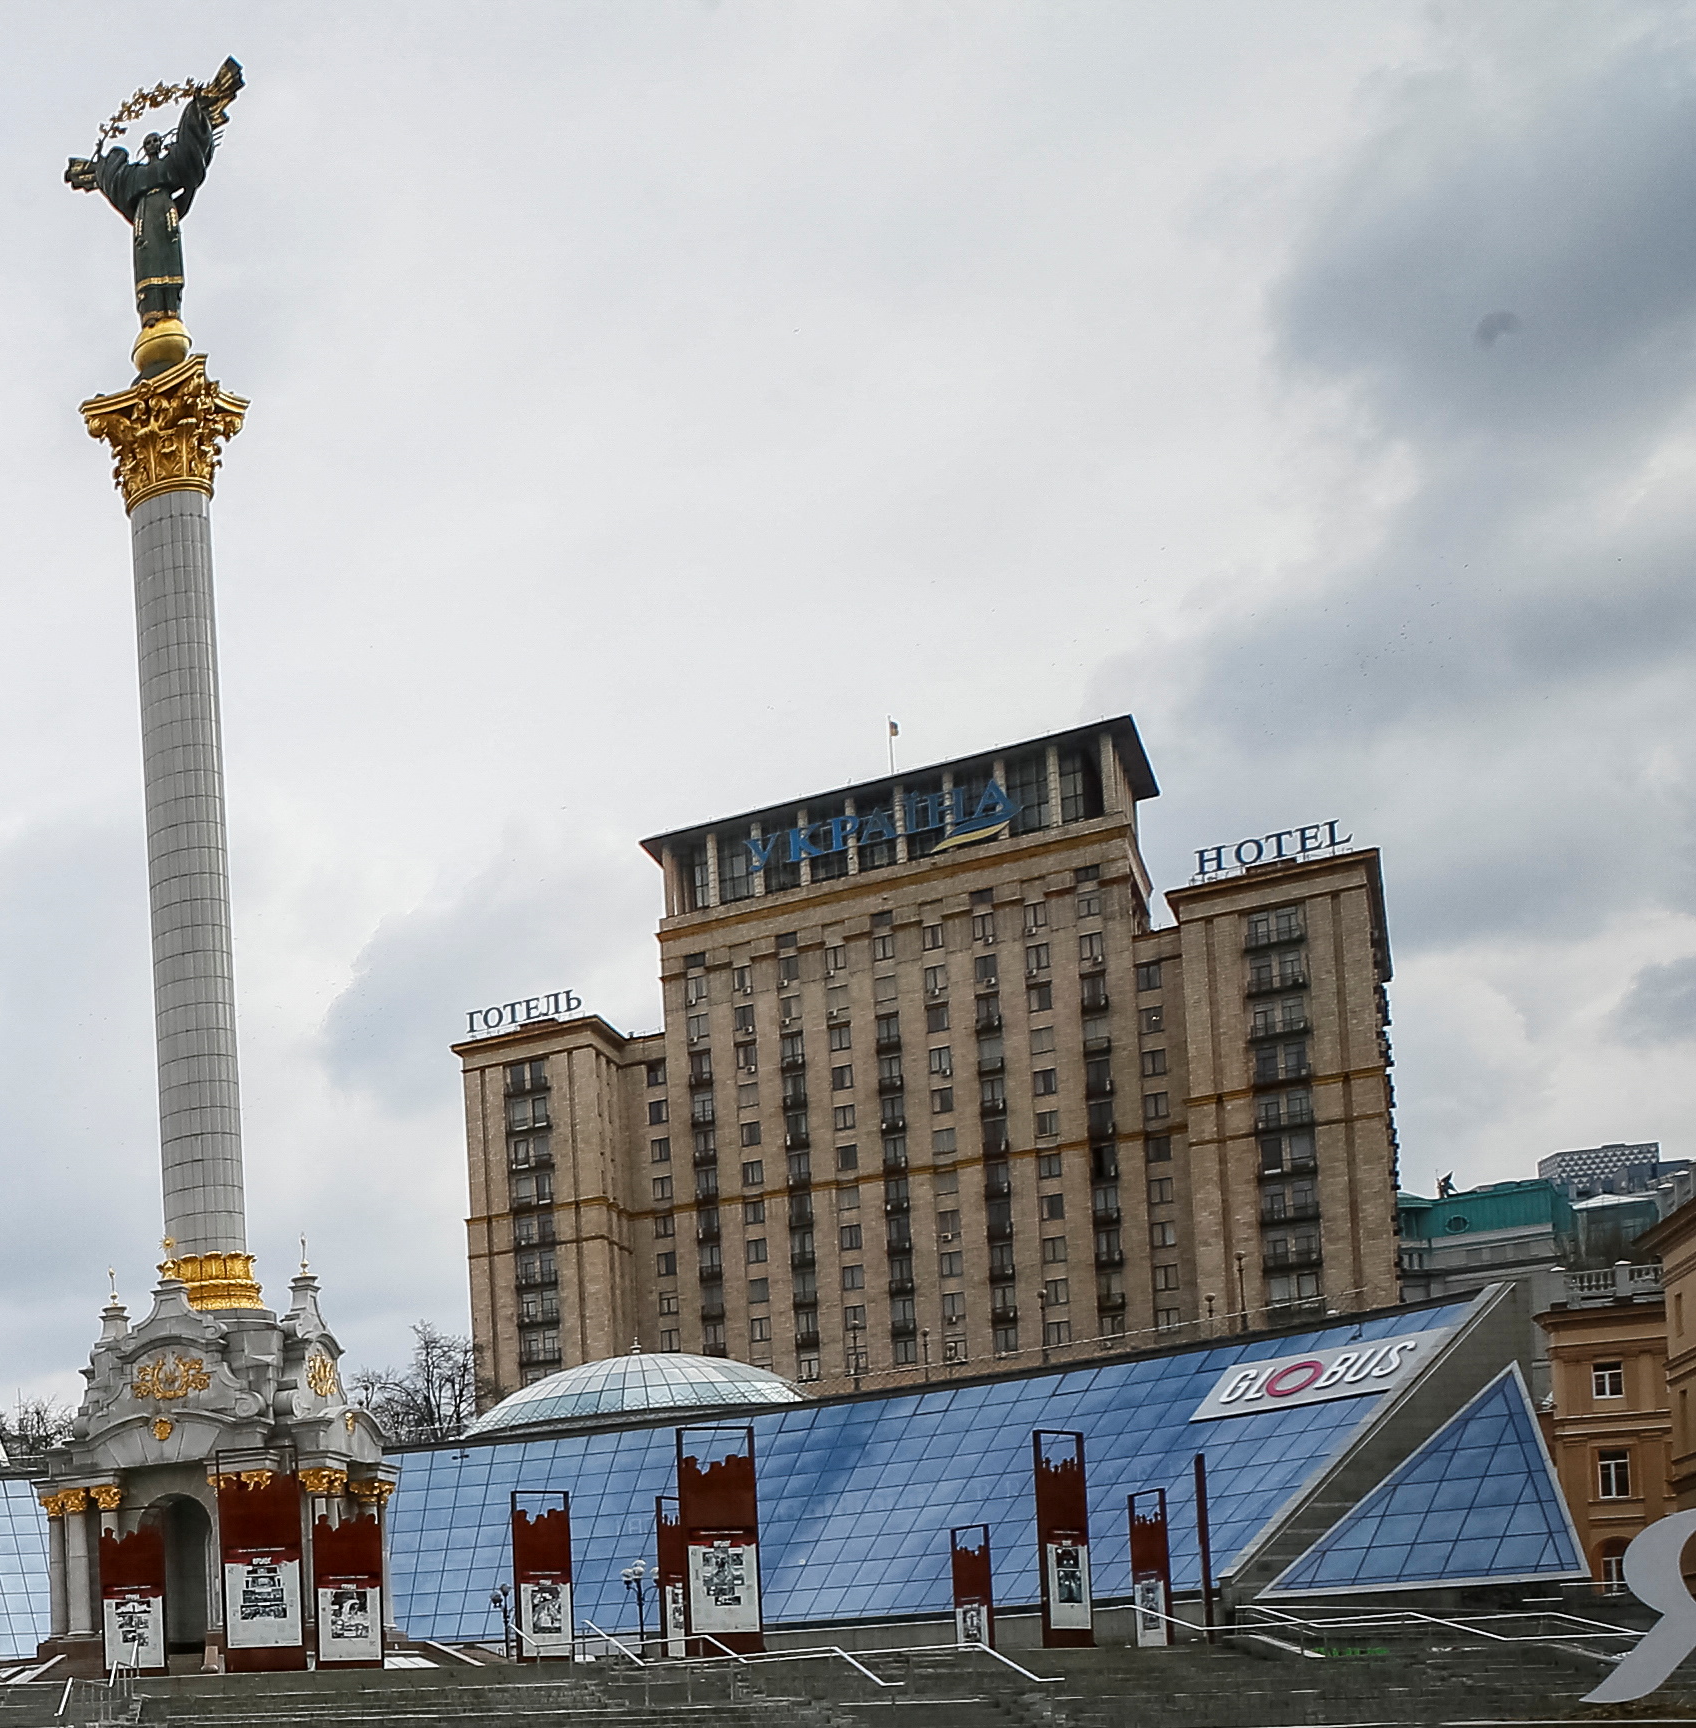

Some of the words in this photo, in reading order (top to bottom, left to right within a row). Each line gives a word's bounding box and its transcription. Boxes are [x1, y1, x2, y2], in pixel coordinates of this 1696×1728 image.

[742, 778, 1017, 871] УКРАЇНА
[1194, 819, 1354, 875] HOTEL
[466, 988, 582, 1033] ГОТЕЛЬ
[1219, 1339, 1418, 1404] GLOBUS
